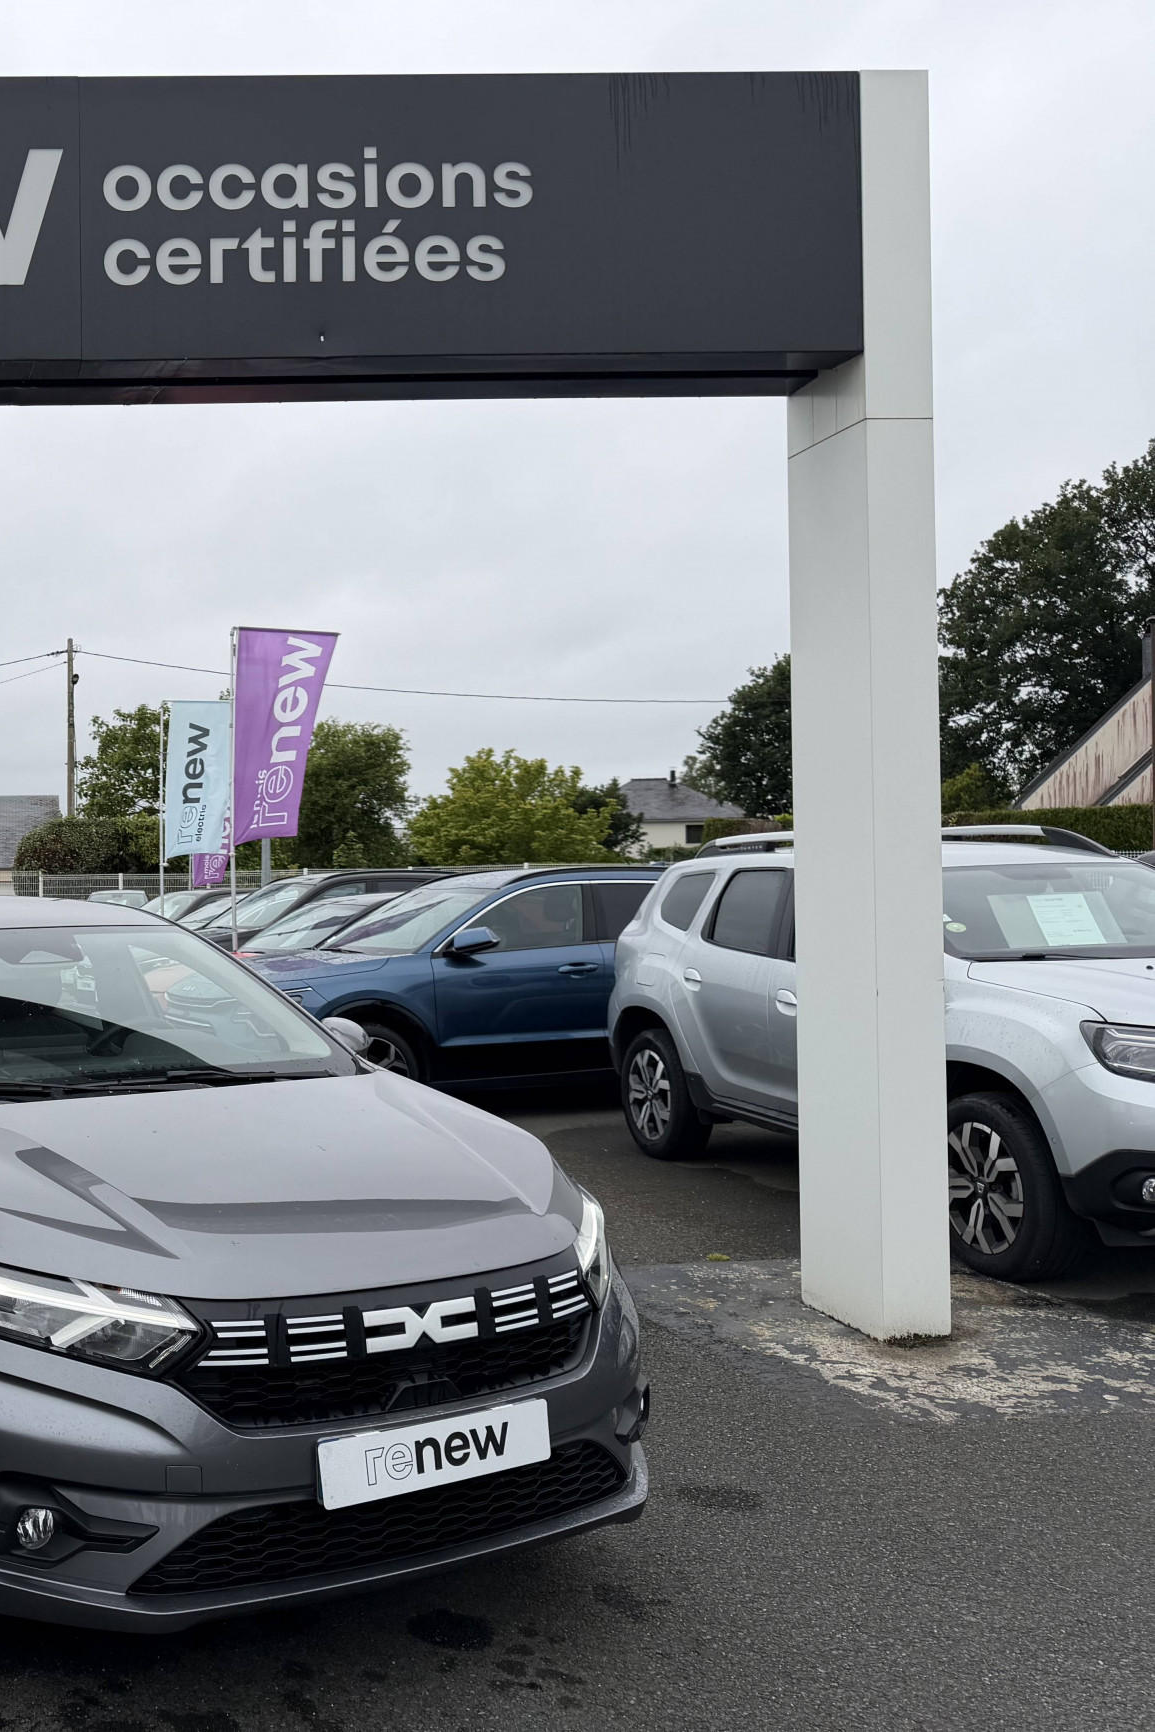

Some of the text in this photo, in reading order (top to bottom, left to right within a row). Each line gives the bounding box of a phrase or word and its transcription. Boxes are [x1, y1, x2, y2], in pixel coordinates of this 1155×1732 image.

[103, 146, 534, 212] occasions
[104, 219, 506, 286] certifiées
[259, 636, 323, 827] renew
[177, 722, 210, 845] renew
[364, 1421, 509, 1486] renew
